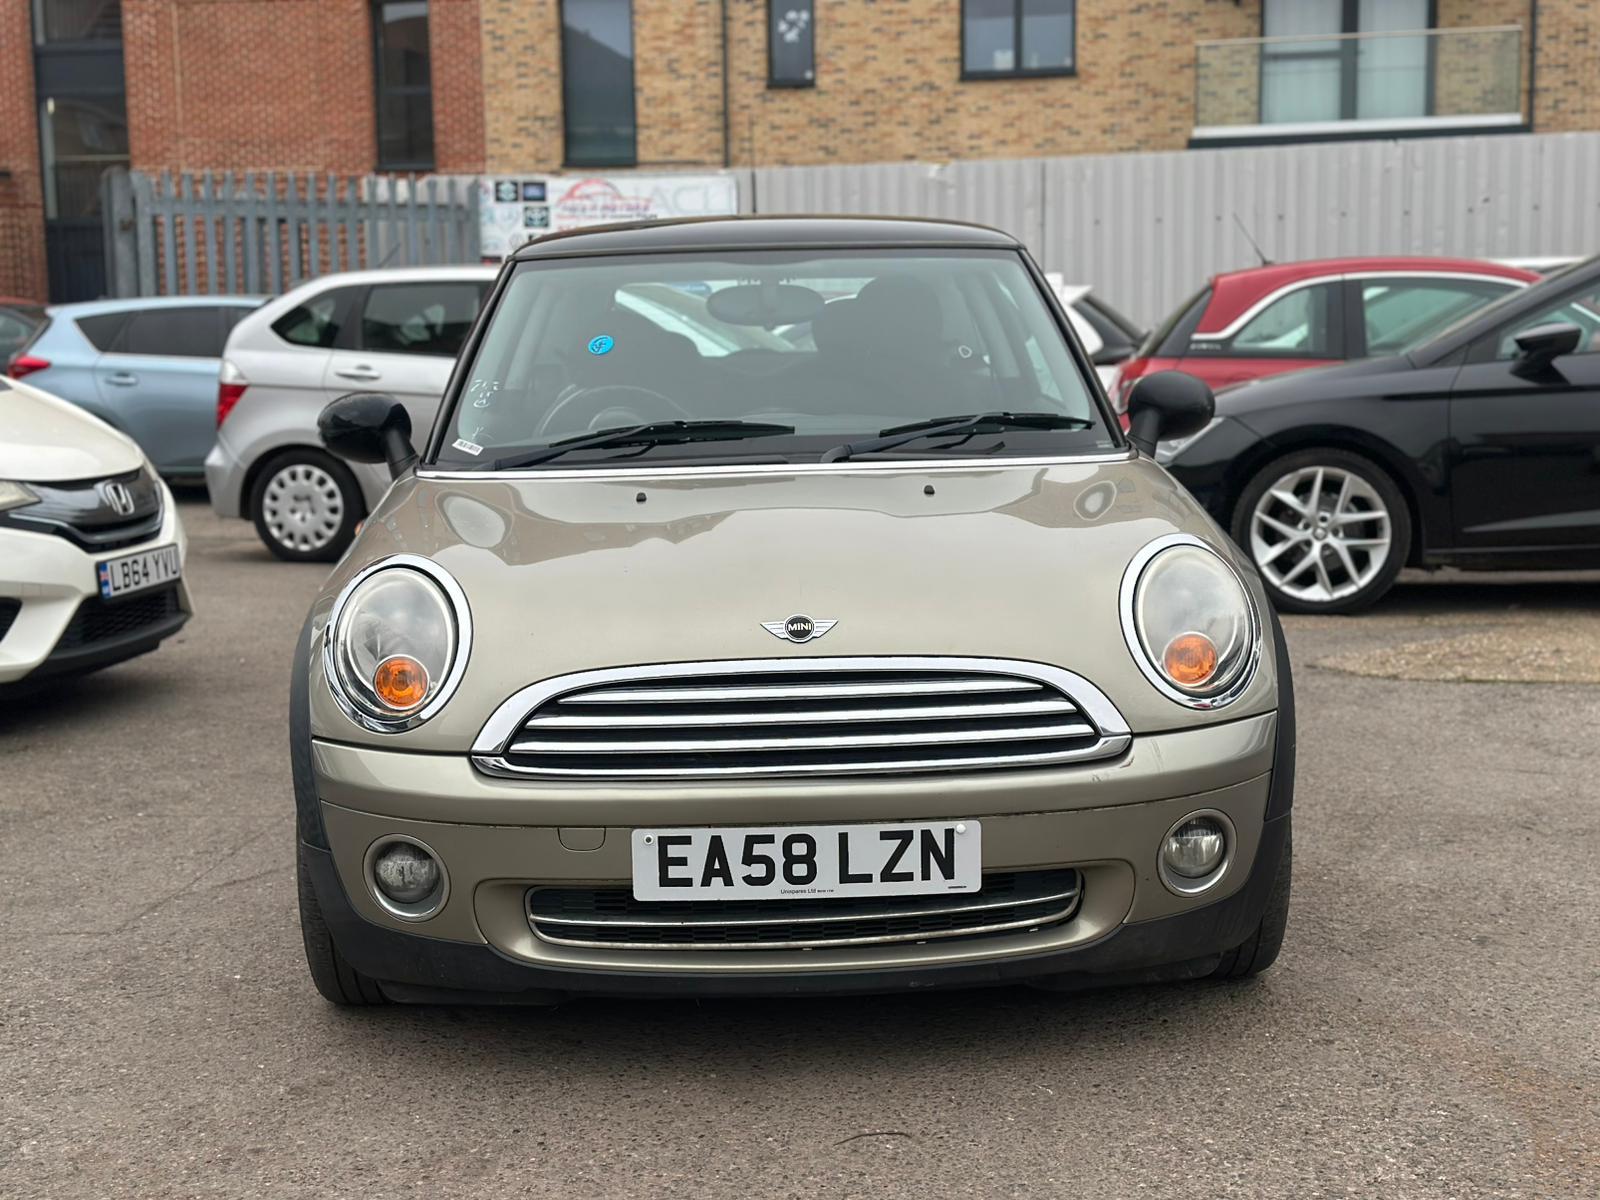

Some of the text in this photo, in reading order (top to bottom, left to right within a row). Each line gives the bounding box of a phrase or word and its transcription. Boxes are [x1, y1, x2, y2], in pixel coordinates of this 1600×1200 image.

[110, 548, 178, 592] LB64 YVU
[788, 622, 811, 631] MINI
[657, 828, 955, 887] EA58 LZN
